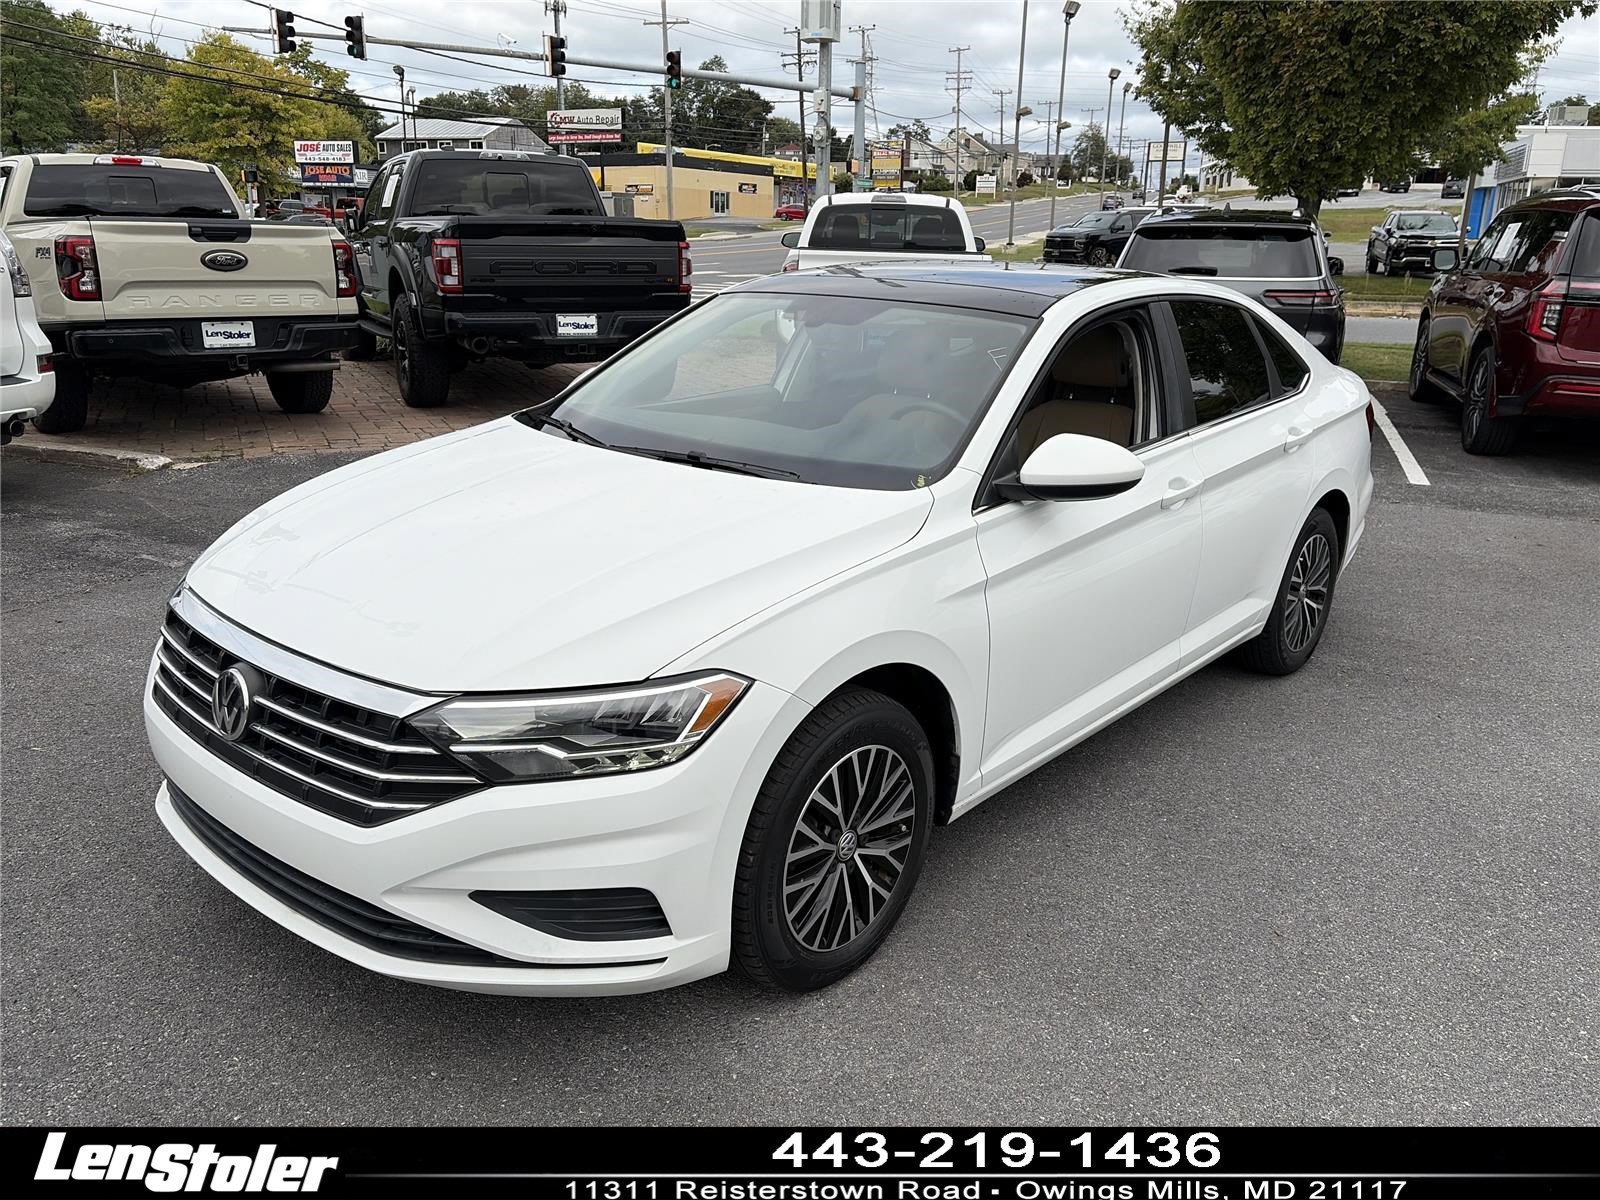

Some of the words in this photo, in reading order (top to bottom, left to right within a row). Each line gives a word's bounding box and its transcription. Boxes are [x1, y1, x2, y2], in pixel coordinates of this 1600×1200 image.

[576, 115, 594, 123] Auto
[595, 115, 620, 125] Repair
[296, 142, 321, 152] JOSÉ
[322, 143, 336, 152] AUTO
[336, 143, 352, 152] SALES
[305, 165, 325, 176] JOSE
[325, 165, 350, 176] AUTO
[35, 247, 51, 258] FX4
[489, 260, 658, 275] FORD
[126, 294, 321, 309] RANGER
